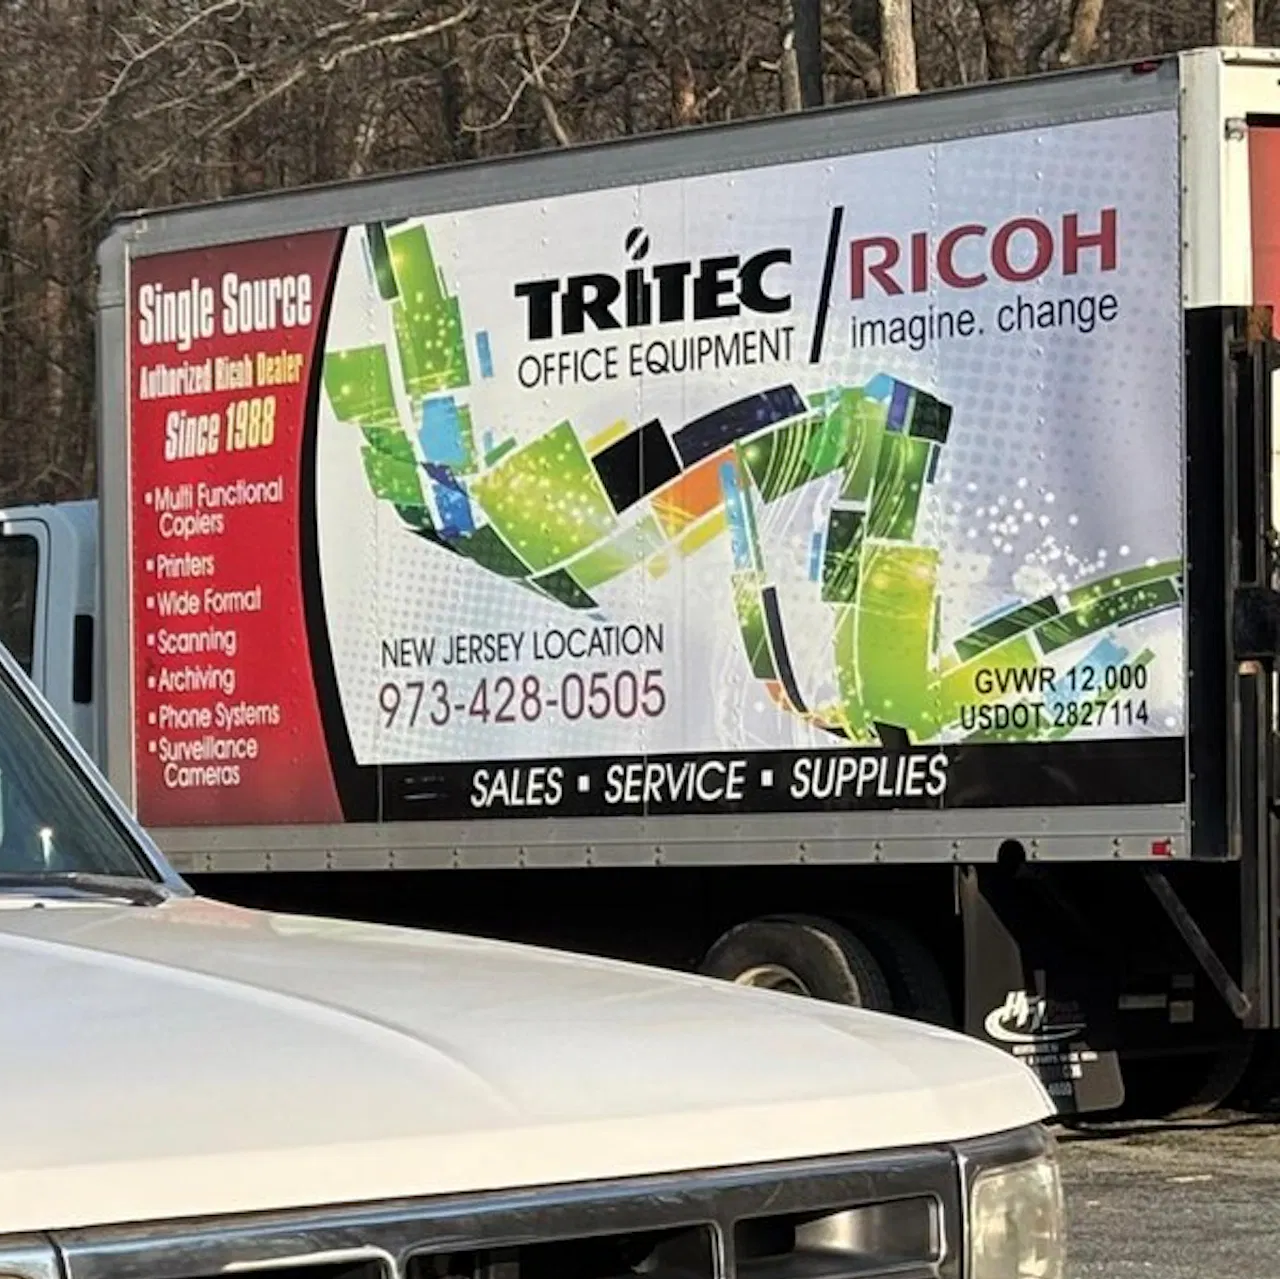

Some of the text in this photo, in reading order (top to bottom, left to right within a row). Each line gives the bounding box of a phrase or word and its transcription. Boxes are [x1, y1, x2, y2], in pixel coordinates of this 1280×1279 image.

[849, 207, 1117, 300] RICOH
[138, 272, 313, 351] Single Source
[851, 294, 1118, 350] imagine. change
[518, 326, 795, 388] OFFICE EQUIPMENT
[140, 350, 304, 400] Authorized Ricoh Dealer
[165, 396, 276, 461] Since 1988
[154, 475, 283, 512] Multi Functional
[159, 509, 224, 540] Copiers
[156, 552, 215, 579] Printers
[157, 584, 262, 617] Wide Format
[157, 625, 237, 656] Scanning
[382, 624, 664, 668] NEW JERSEY LOCATION
[157, 664, 236, 695] Archiving
[975, 664, 1147, 694] GVWR 12,000
[158, 701, 280, 731] Phone Systems
[379, 669, 666, 728] 973-428-0505
[960, 700, 1149, 730] USDOT 2827114
[158, 736, 258, 762] Surveillance
[164, 762, 240, 788] Cameras
[470, 753, 948, 808] SALES SERVICE SUPPLIES
